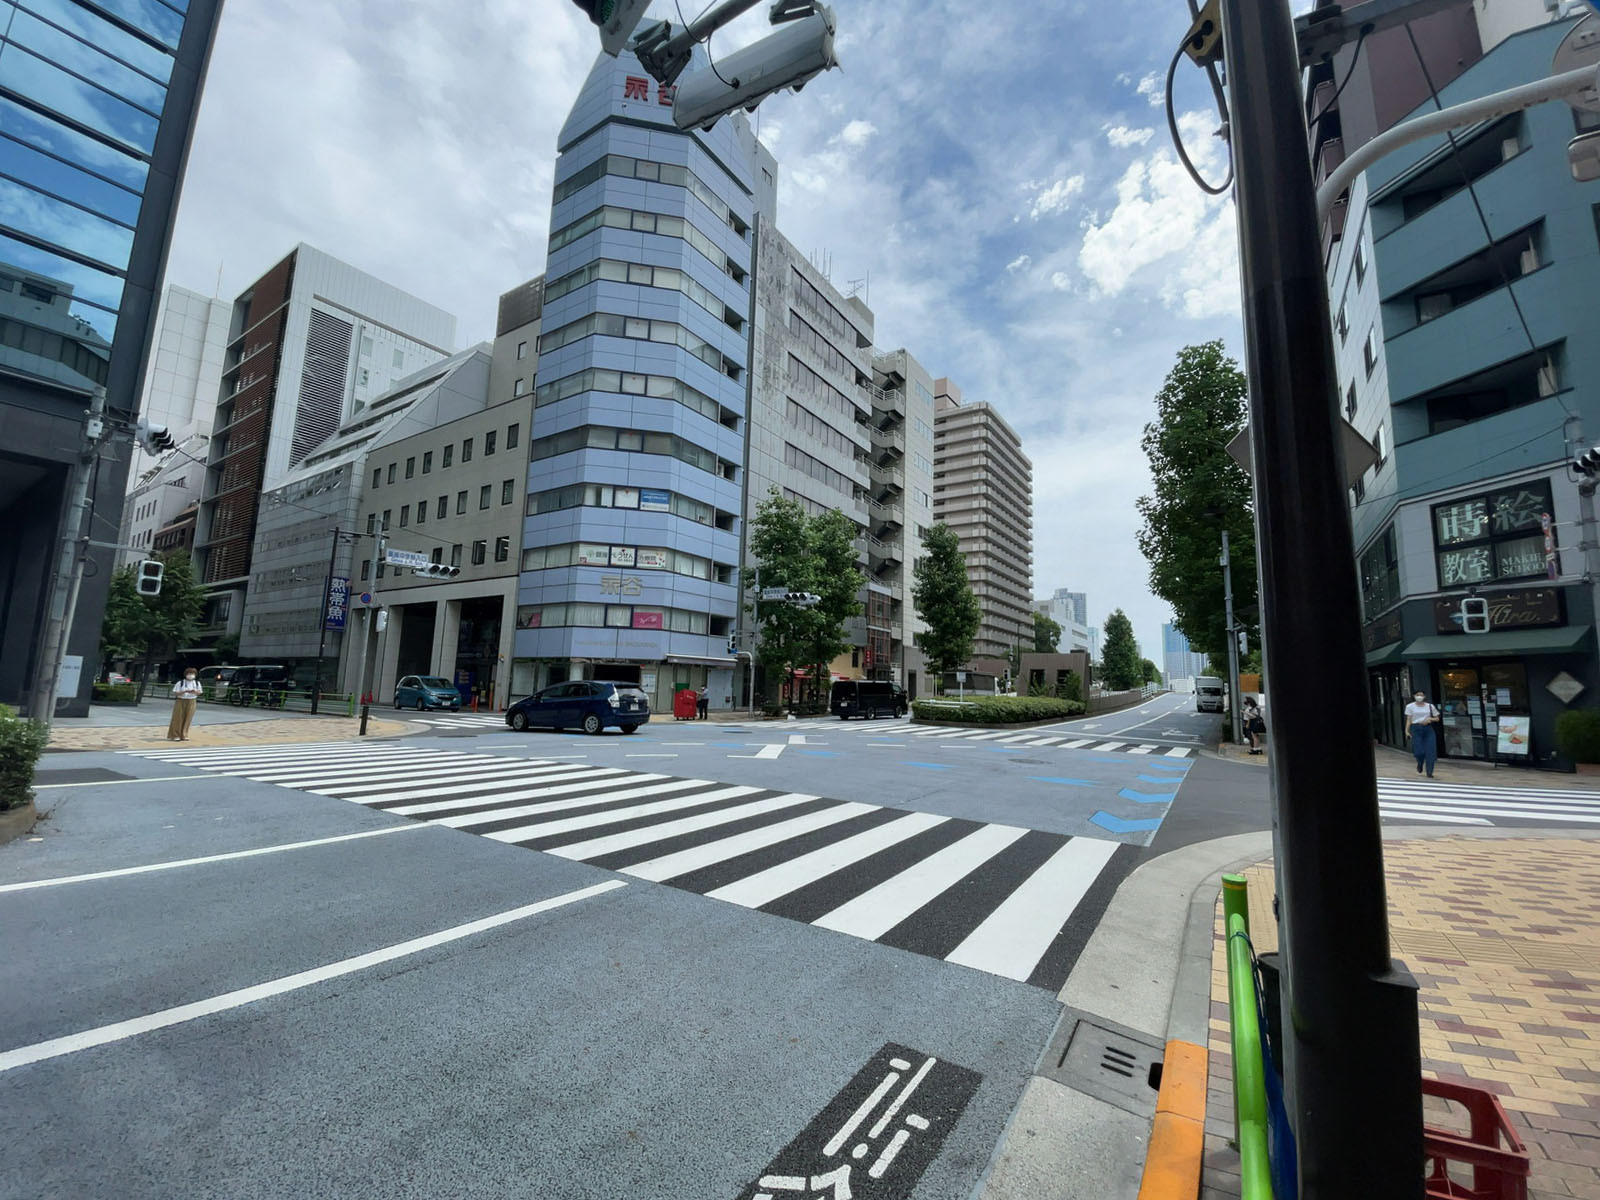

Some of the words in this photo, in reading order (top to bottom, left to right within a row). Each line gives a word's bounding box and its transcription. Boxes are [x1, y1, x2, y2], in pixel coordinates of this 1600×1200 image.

[1444, 550, 1491, 583] 教室
[1502, 553, 1542, 566] MAKIE
[327, 578, 346, 621] 熱帯魚
